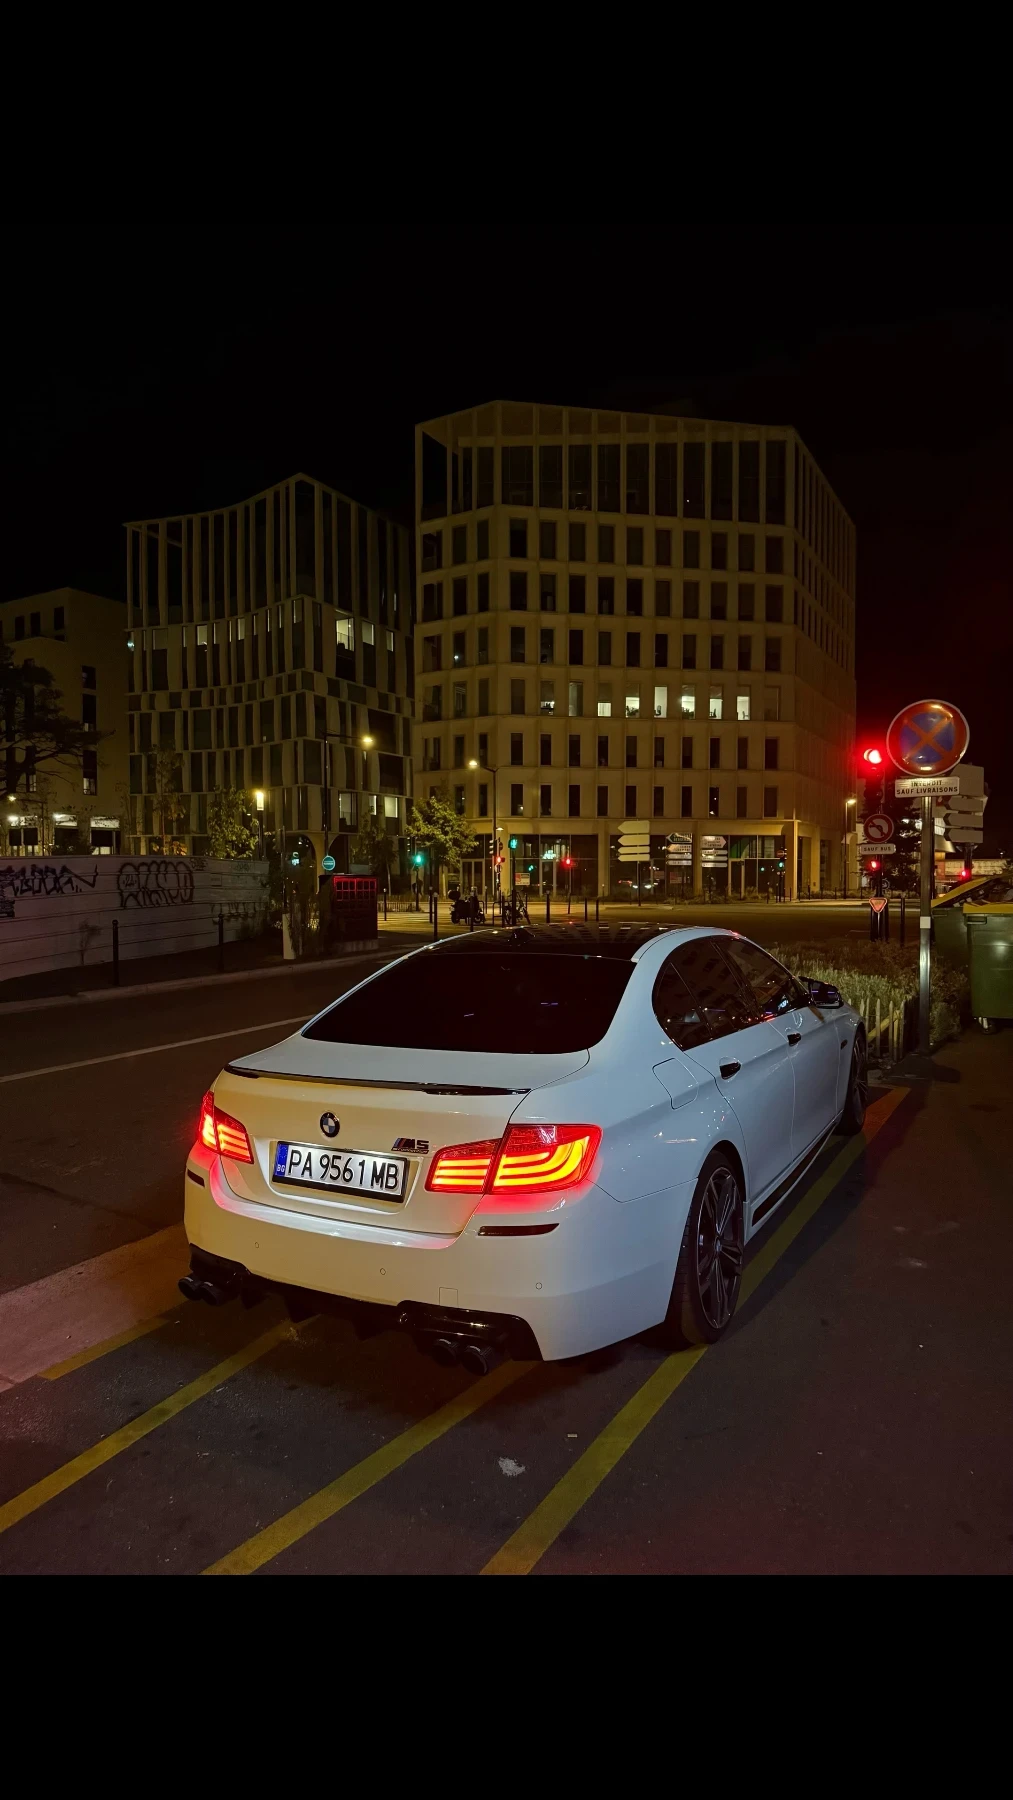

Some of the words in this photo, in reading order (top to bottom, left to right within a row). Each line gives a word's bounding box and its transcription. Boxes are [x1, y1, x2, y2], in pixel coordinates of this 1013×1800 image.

[916, 786, 958, 794] LIVRAISONS
[399, 1137, 430, 1150] M5
[276, 1163, 285, 1174] BG
[287, 1149, 313, 1178] PA
[319, 1153, 366, 1186] 9561
[370, 1160, 399, 1190] MB
